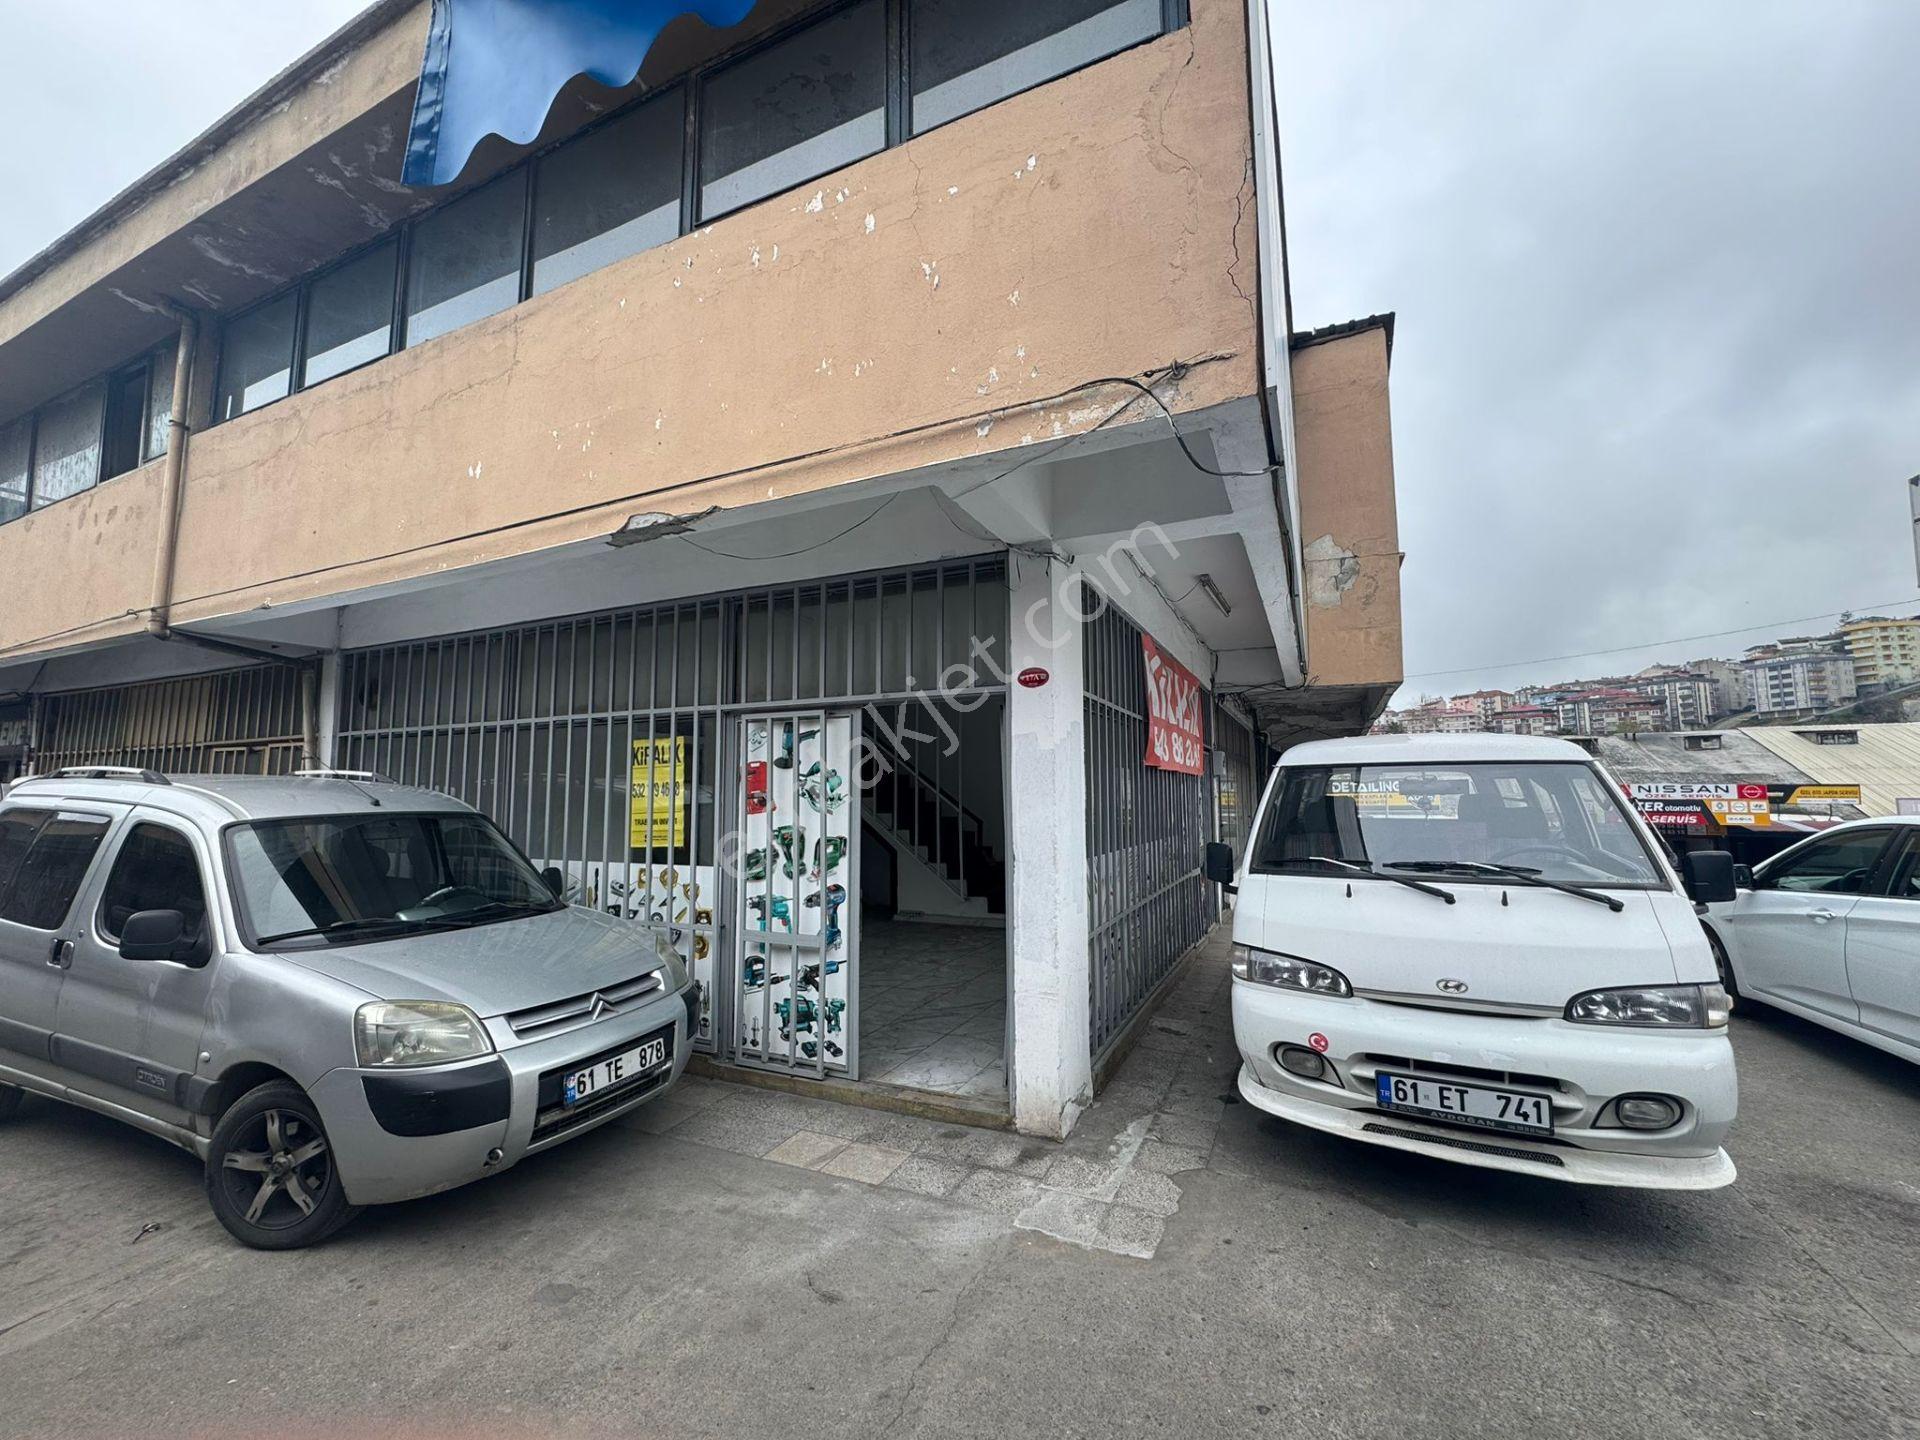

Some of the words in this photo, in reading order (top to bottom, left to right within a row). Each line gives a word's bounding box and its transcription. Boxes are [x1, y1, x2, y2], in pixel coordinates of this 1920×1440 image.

[1637, 785, 1730, 793] NISSAN
[577, 1069, 595, 1095] 61
[605, 1058, 623, 1082] TE
[639, 1041, 663, 1068] 878
[1380, 1089, 1390, 1098] TR
[1393, 1079, 1419, 1104] 61
[1438, 1086, 1469, 1112] ET
[1496, 1095, 1543, 1124] 741
